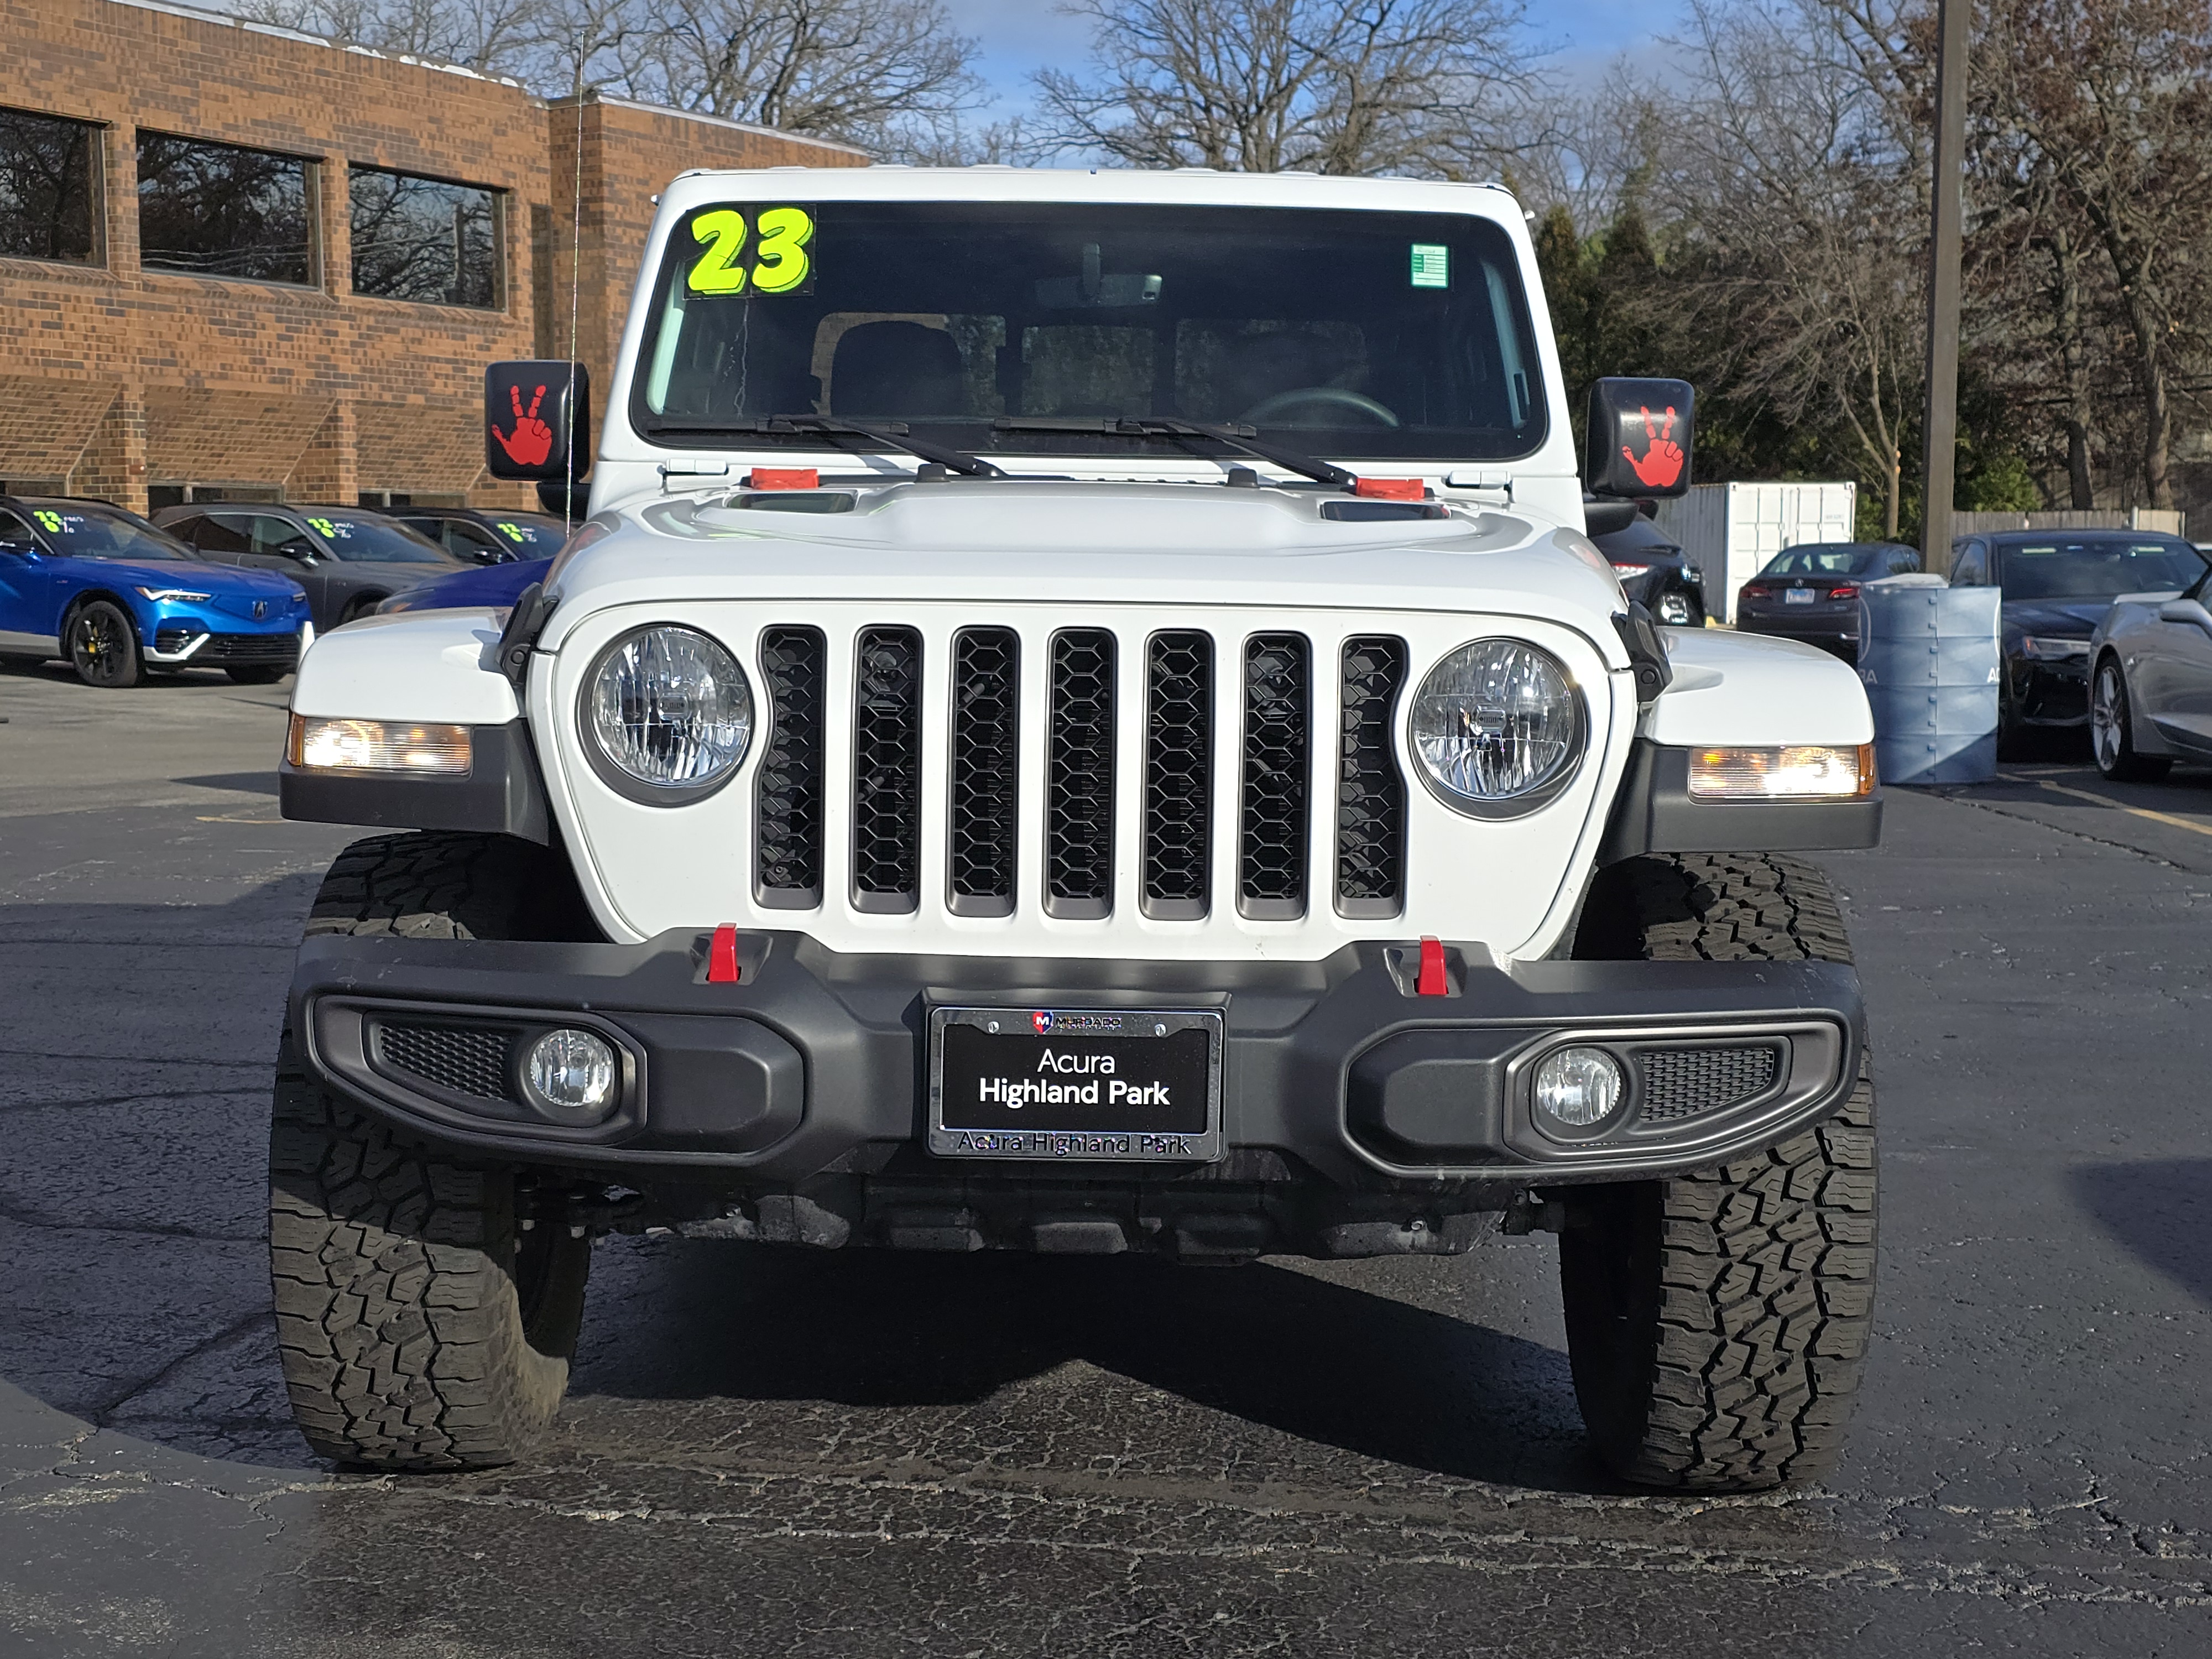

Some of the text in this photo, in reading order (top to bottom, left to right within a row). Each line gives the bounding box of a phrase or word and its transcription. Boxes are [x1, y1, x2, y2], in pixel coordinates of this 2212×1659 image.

[688, 208, 814, 295] 23
[1037, 1048, 1115, 1074] Acura
[980, 1078, 1170, 1108] Highland Park
[957, 1131, 1192, 1155] Acura Highland Park
